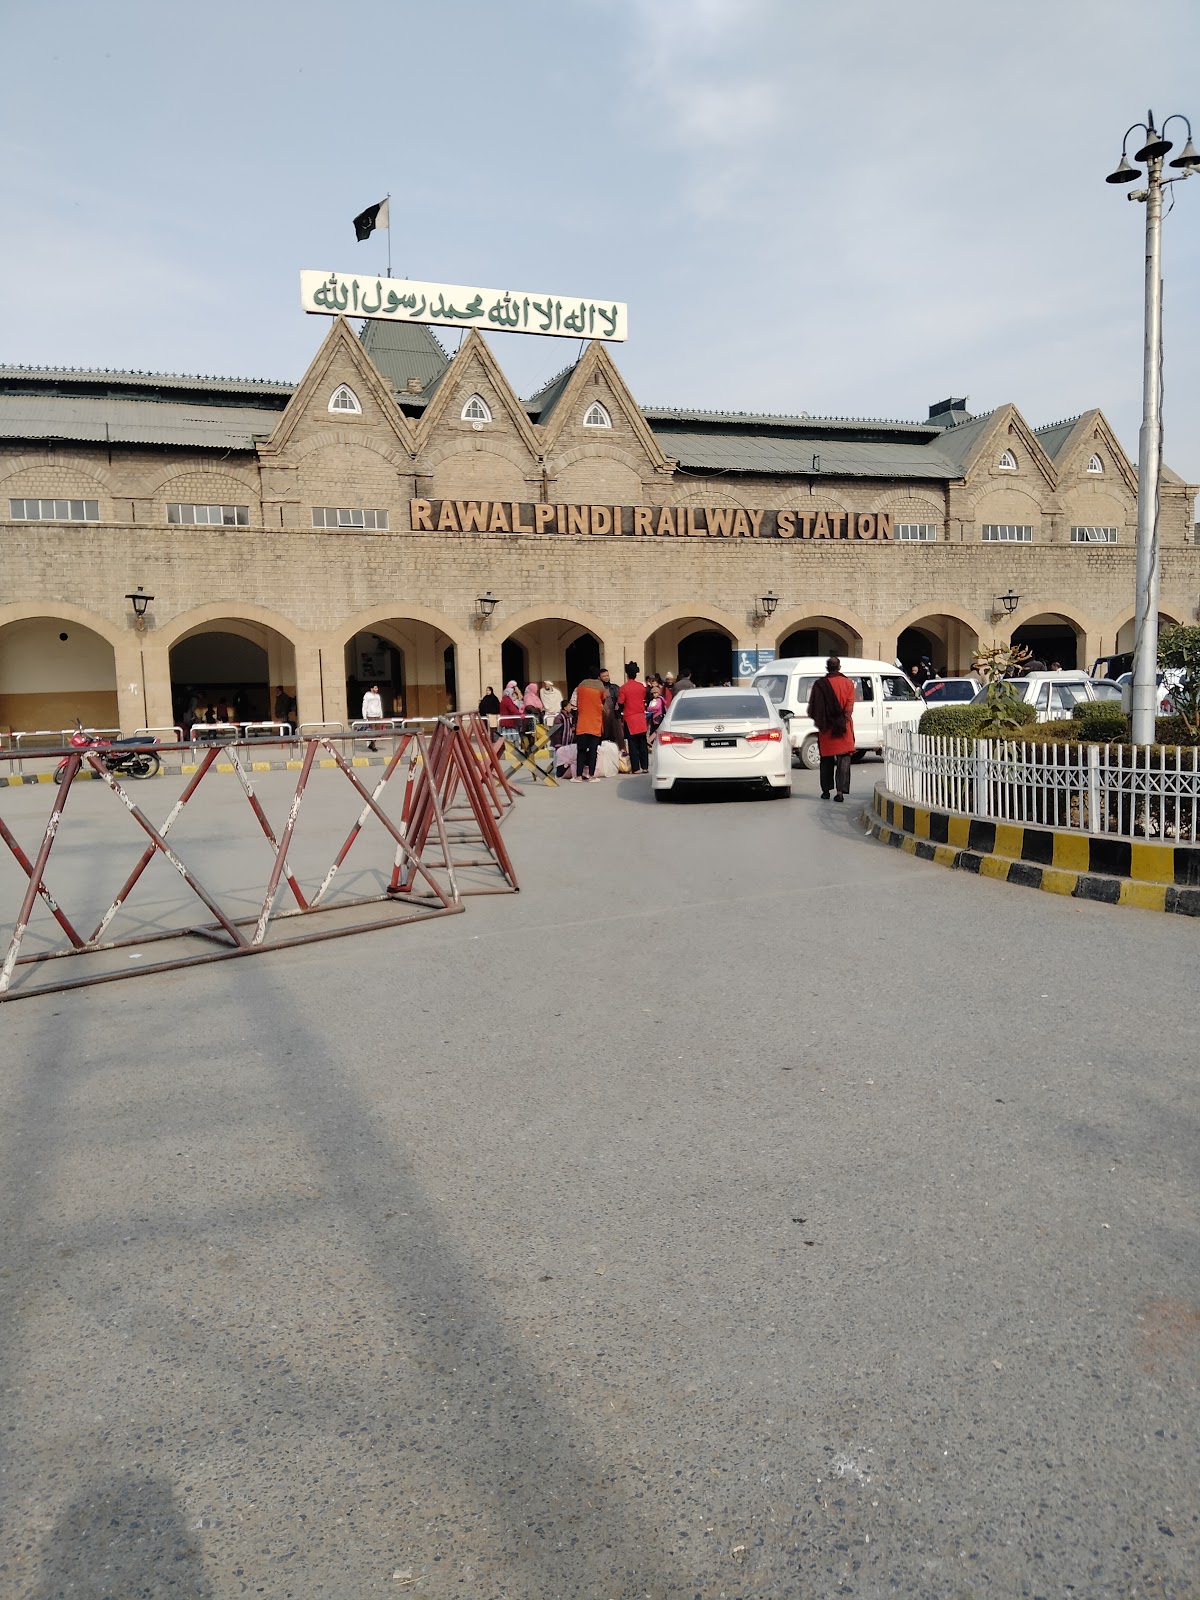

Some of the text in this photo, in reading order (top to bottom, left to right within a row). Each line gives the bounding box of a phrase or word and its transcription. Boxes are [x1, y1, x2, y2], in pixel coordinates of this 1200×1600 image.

[313, 272, 360, 311] الله
[361, 279, 427, 318] رسول
[430, 293, 485, 319] محمد
[488, 291, 530, 328] الله
[598, 304, 618, 337] لا
[410, 498, 894, 540] RAWALPINDI RAILWAY STATION
